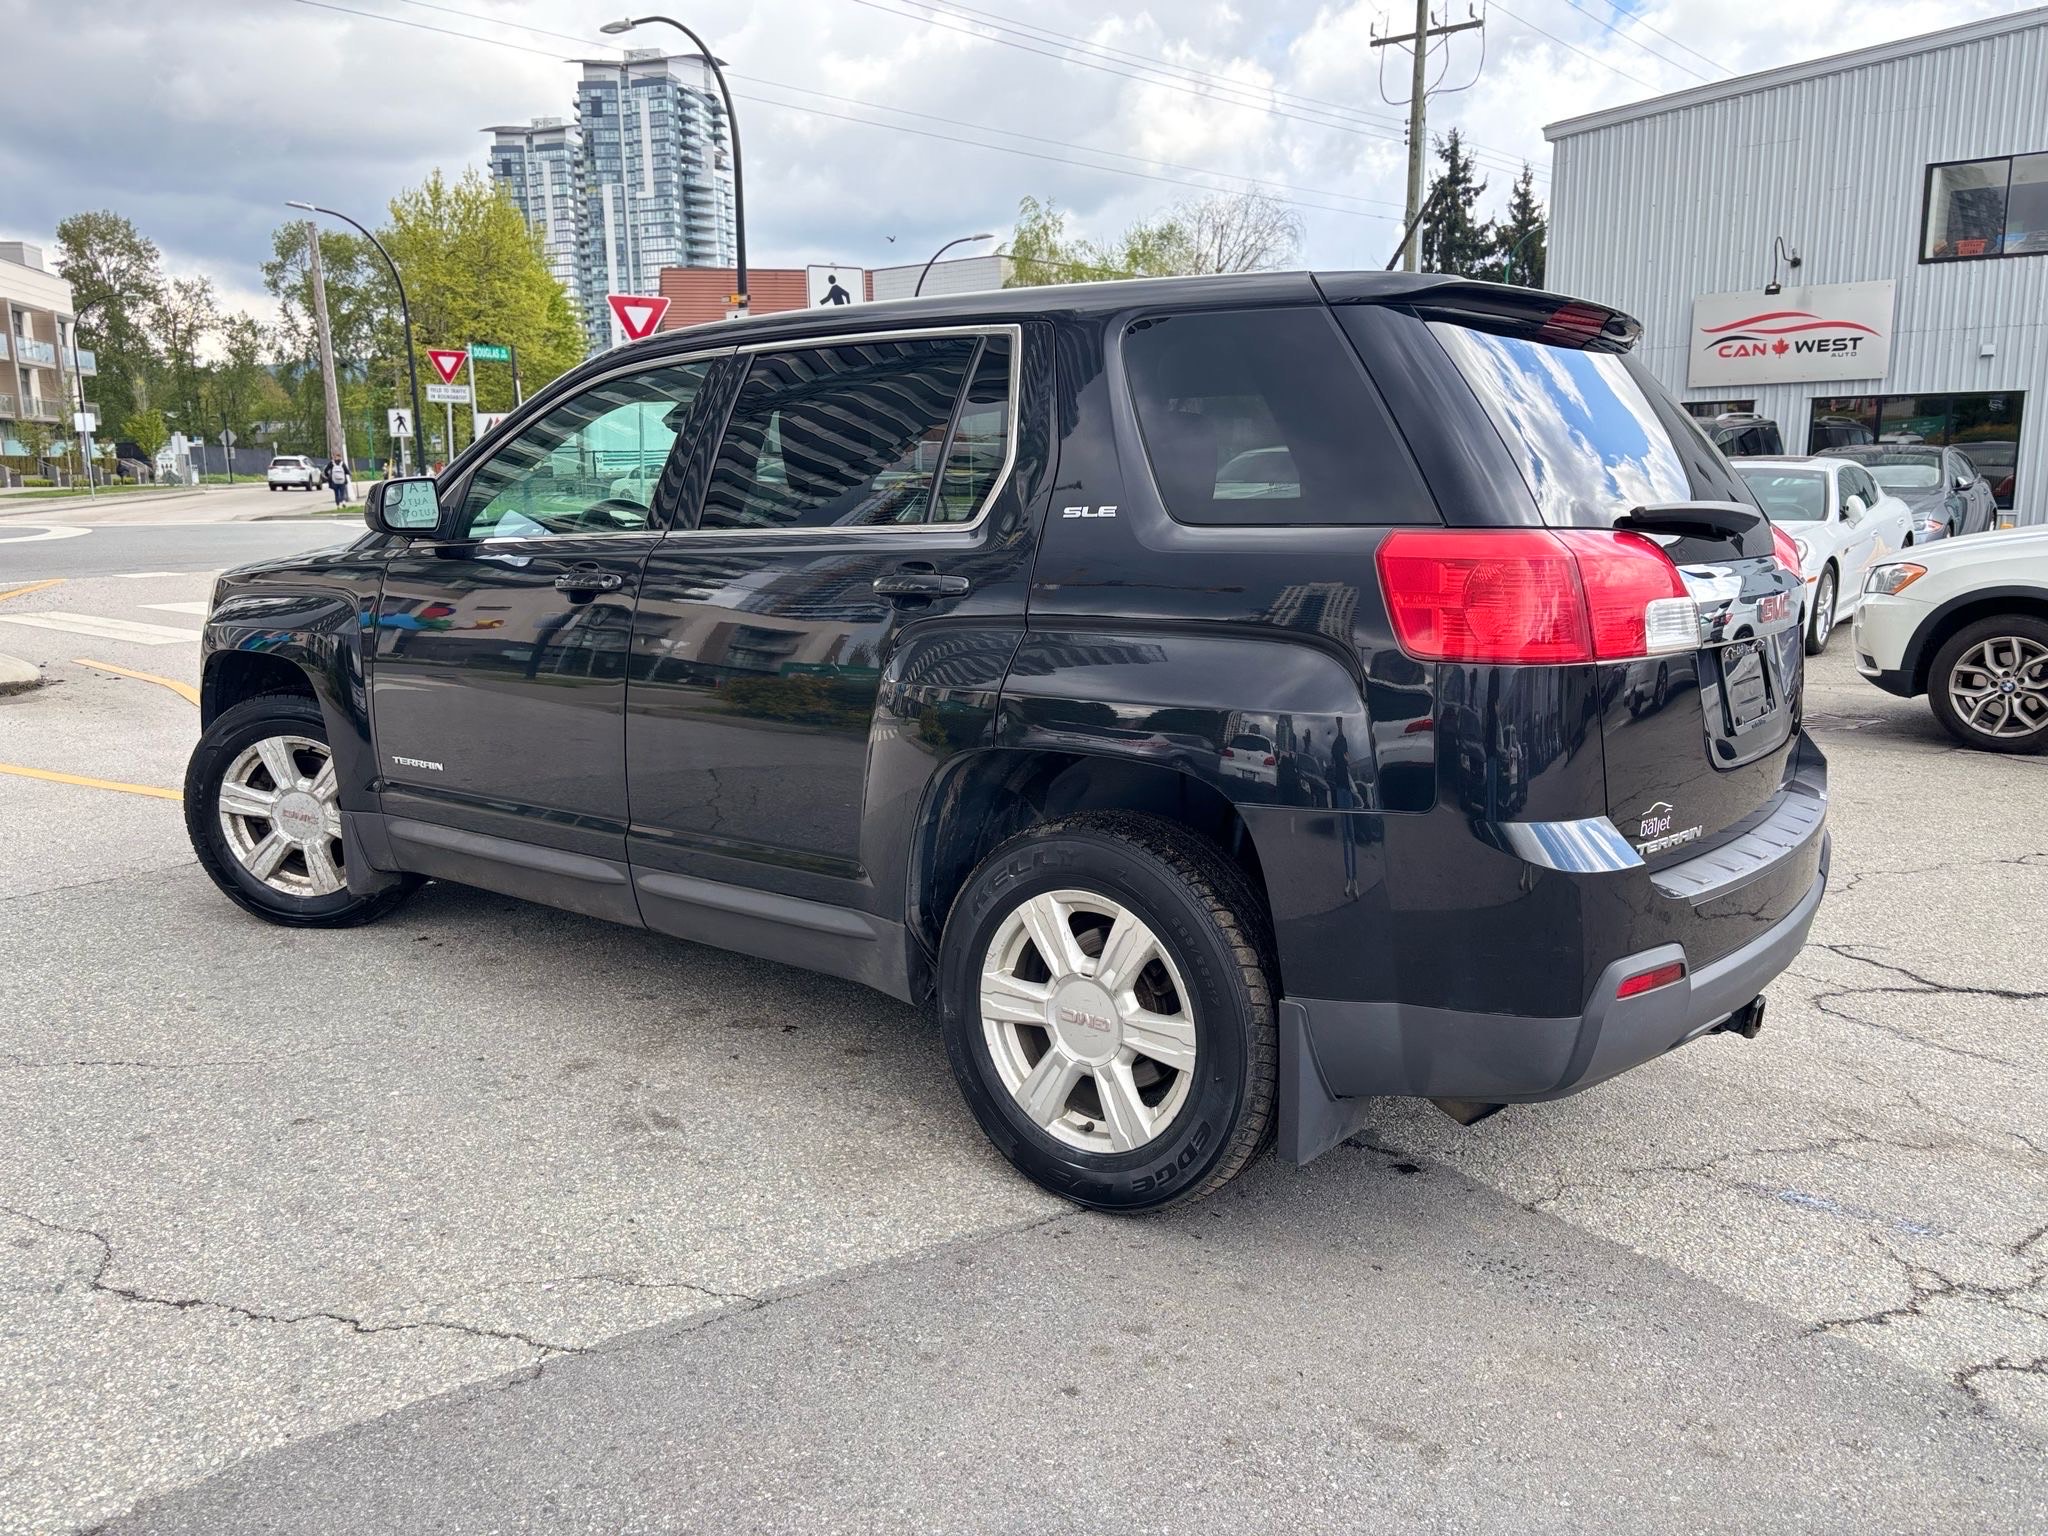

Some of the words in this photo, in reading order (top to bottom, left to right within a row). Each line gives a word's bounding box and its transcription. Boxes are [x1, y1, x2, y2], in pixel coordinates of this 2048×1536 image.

[473, 347, 499, 359] DOUGLAS
[1718, 343, 1767, 358] CAN
[1795, 337, 1864, 354] WEST
[1063, 505, 1117, 519] SLE
[1758, 591, 1791, 623] GMC
[391, 755, 444, 771] TERRAIN
[1640, 815, 1671, 838] baljet
[1636, 825, 1703, 856] TERRAIN
[1060, 1007, 1111, 1032] GMC
[1132, 1120, 1212, 1194] EDGE
